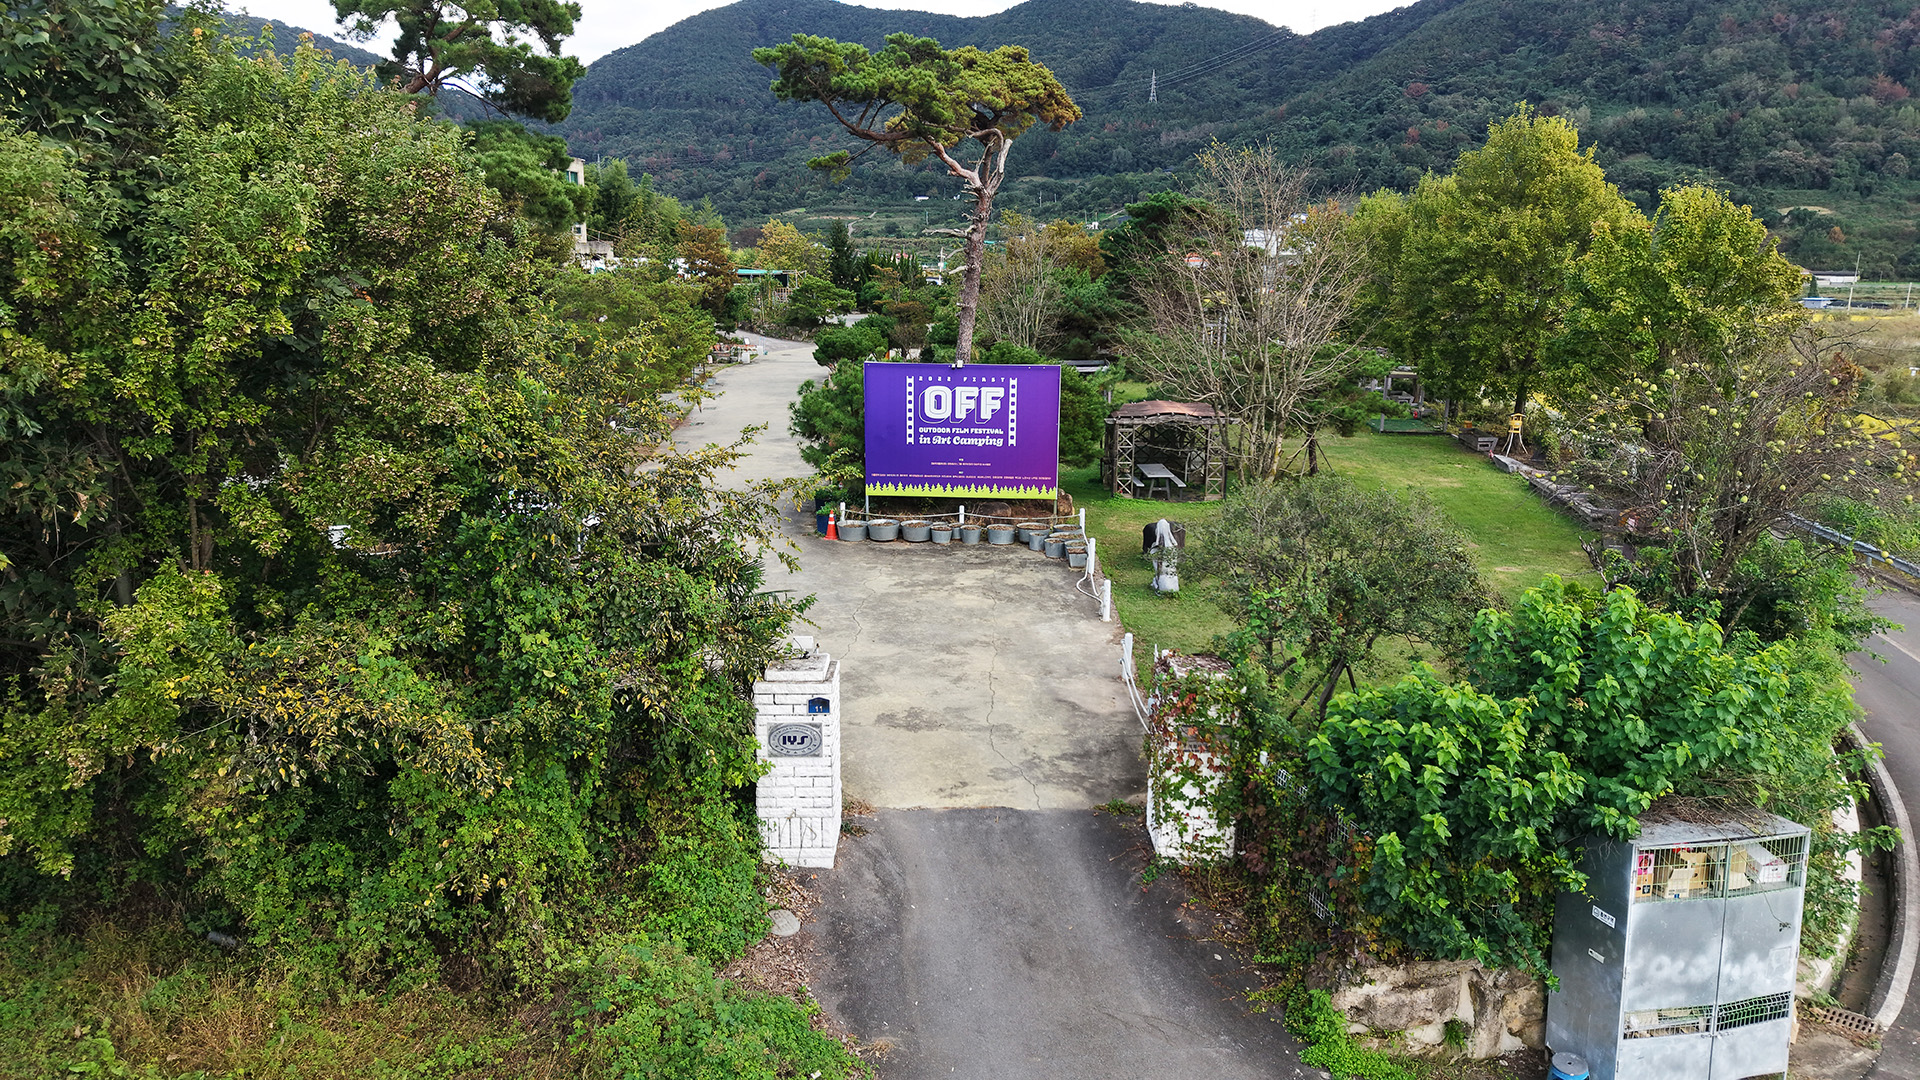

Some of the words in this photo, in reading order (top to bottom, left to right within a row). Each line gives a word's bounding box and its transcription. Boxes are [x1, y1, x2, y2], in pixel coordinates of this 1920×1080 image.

[919, 385, 1005, 424] OFF
[918, 434, 931, 445] in
[932, 435, 952, 445] Art
[952, 435, 1004, 447] Camping
[782, 735, 809, 745] IYS
